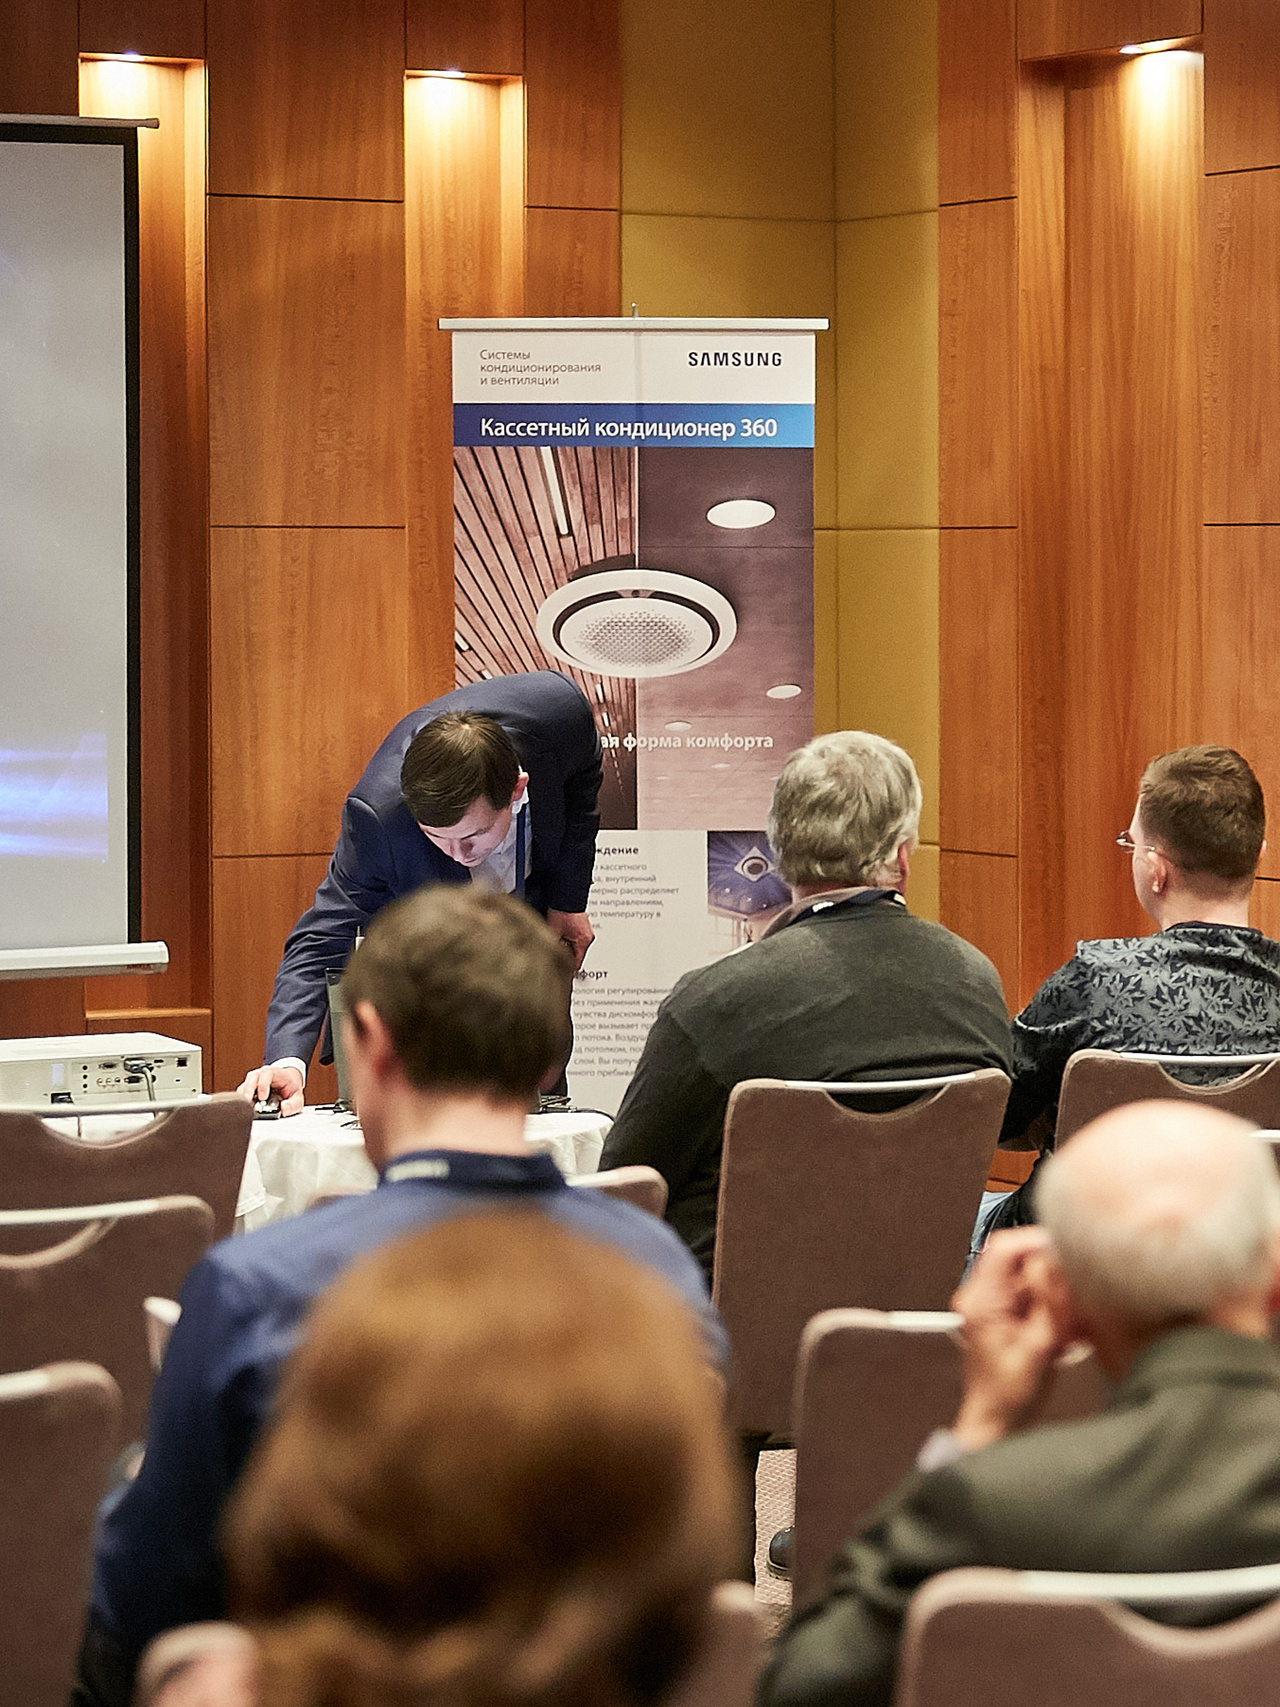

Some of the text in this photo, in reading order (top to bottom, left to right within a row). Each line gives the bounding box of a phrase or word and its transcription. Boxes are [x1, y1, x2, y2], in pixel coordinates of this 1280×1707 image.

[479, 349, 531, 360] Системы
[688, 351, 782, 367] SAMSUNG
[480, 364, 602, 374] кондиционирования
[480, 377, 560, 387] и вентиляции
[480, 418, 778, 441] Кассетный кондиционер 360
[600, 733, 774, 752] ая форма комфорта
[596, 847, 639, 856] ждение
[576, 969, 608, 981] форт
[608, 1009, 657, 1019] дискомфор
